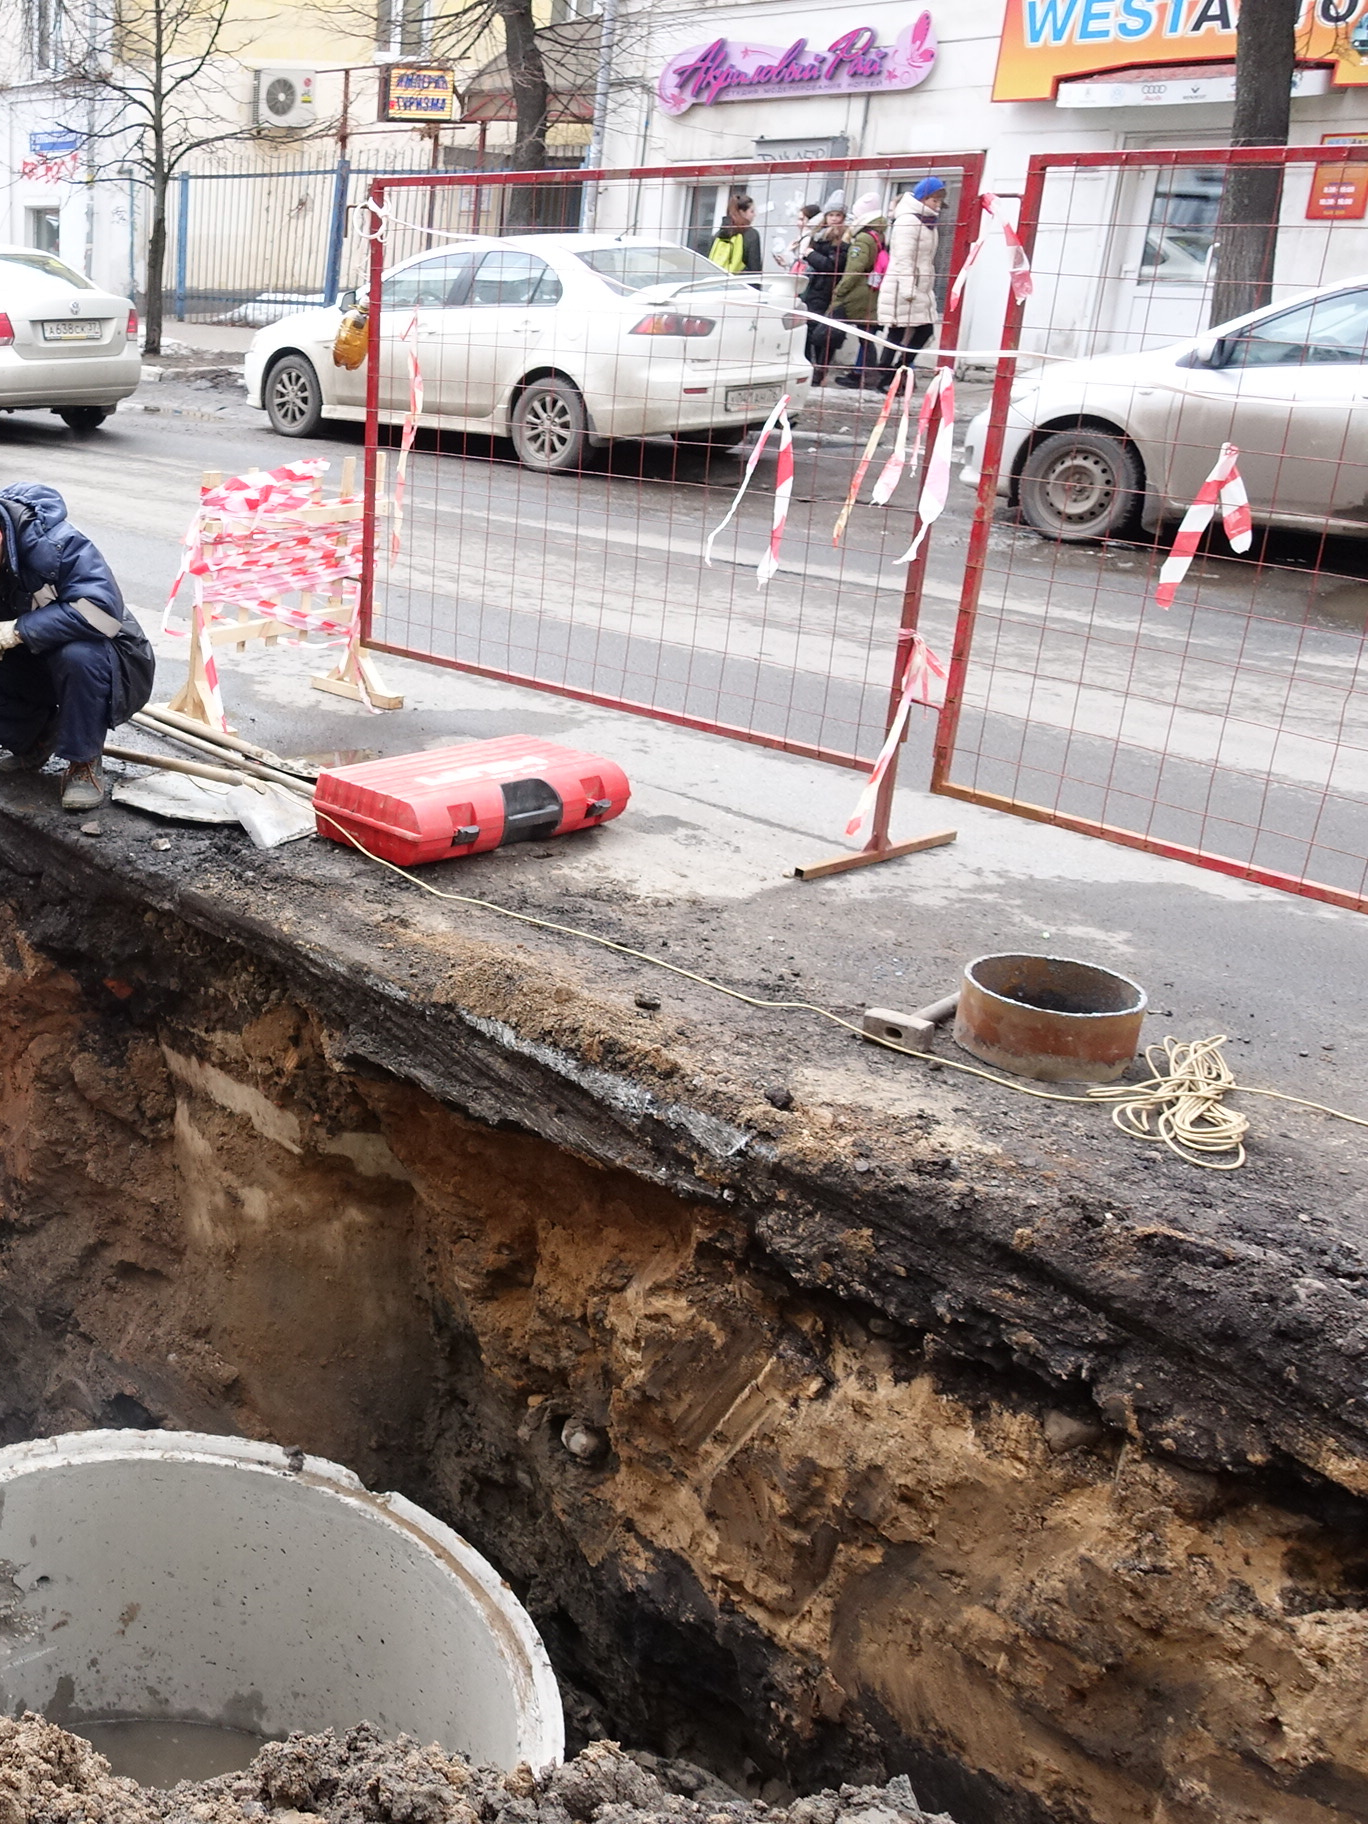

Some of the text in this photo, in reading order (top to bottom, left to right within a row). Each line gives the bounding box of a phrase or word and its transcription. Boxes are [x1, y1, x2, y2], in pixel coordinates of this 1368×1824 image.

[1024, 0, 1351, 43] WESTAO
[673, 26, 886, 106] Акриловый Рай
[395, 95, 447, 111] ТУРИЗМА
